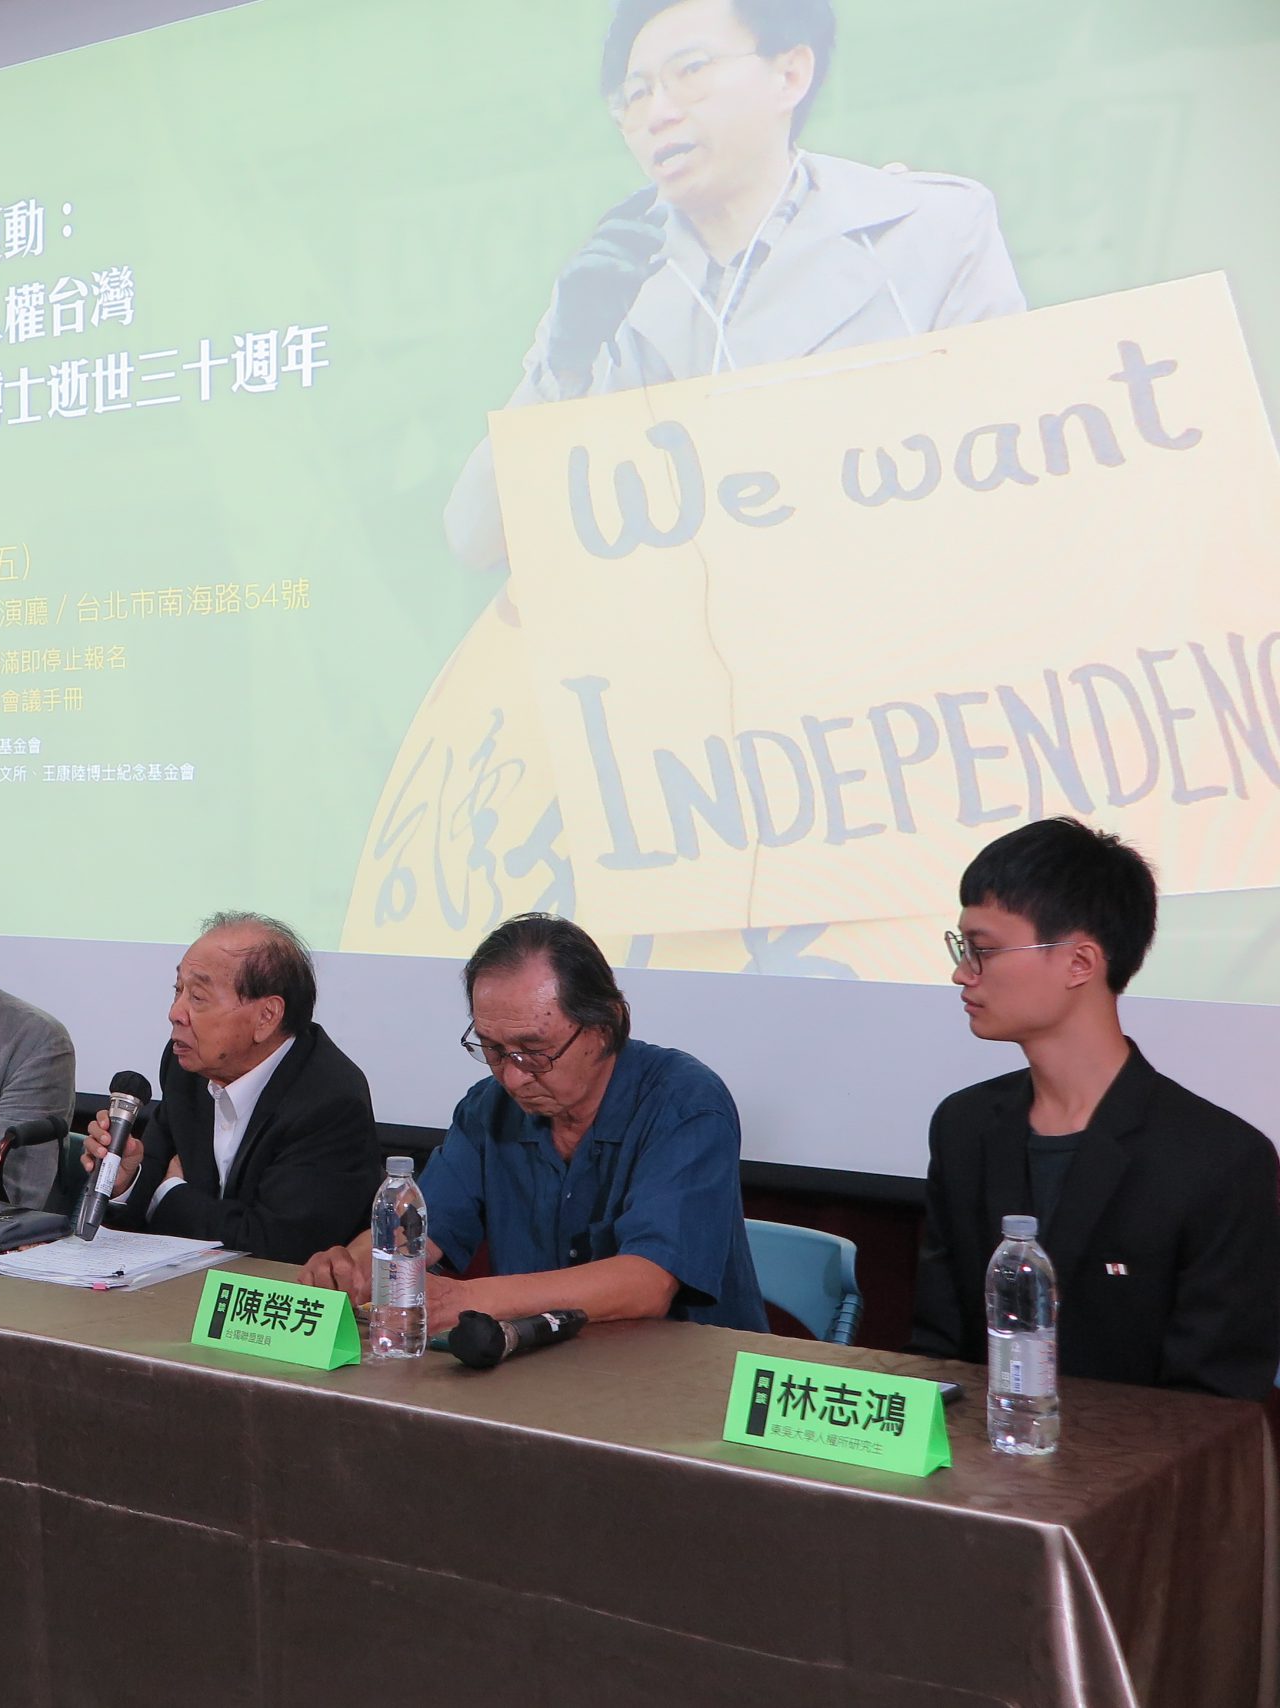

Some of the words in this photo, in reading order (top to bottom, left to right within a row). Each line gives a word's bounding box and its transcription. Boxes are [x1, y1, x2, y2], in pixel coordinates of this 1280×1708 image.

[568, 419, 796, 560] We
[840, 338, 1204, 510] want
[229, 1287, 325, 1337] 陳榮芳
[776, 1373, 907, 1438] 林志鴻
